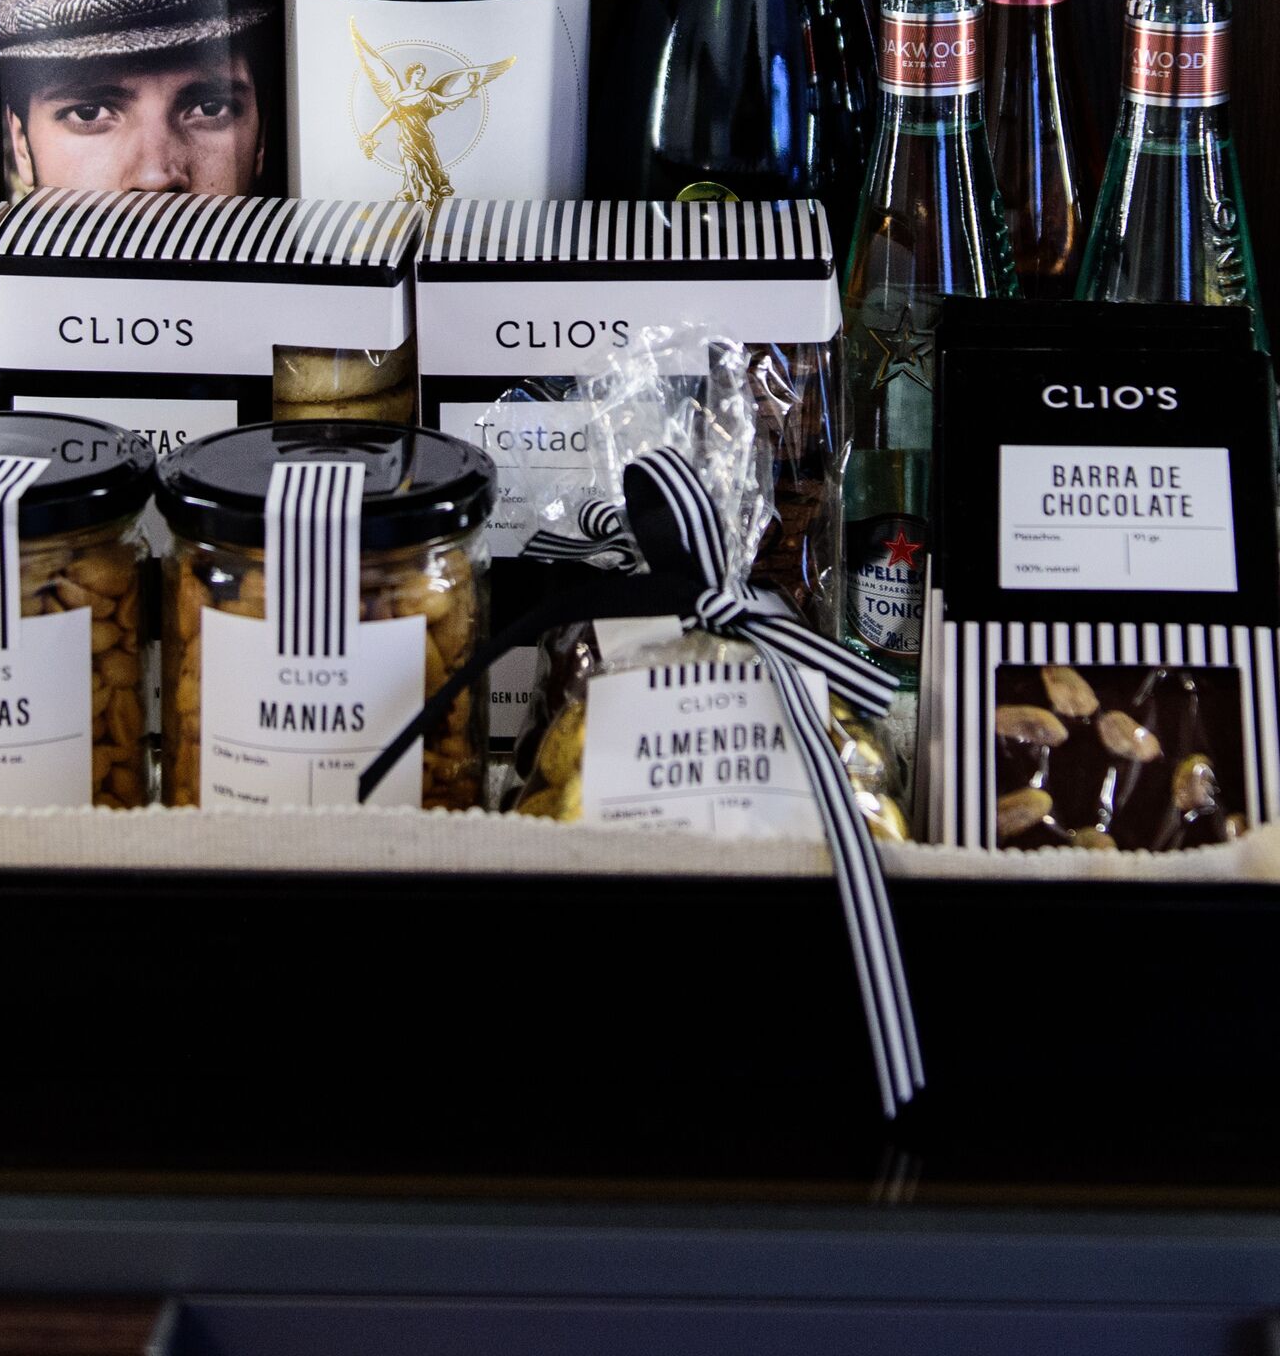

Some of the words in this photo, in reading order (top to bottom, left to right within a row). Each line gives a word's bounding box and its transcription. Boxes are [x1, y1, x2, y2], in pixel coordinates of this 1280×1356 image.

[59, 316, 193, 346] CLIO'S
[496, 320, 629, 348] CLIO'S
[1041, 385, 1179, 411] CLIO'S
[474, 424, 589, 452] Tostad
[1052, 464, 1137, 489] BARRA
[1150, 467, 1182, 489] DE
[1042, 494, 1194, 518] CHOCOLATE
[278, 668, 349, 686] CLIO'S
[259, 701, 366, 732] MANIAS
[678, 693, 748, 714] CLIO'S
[636, 723, 788, 762] ALMENDRA
[648, 761, 705, 790] CON
[719, 755, 771, 784] ORO
